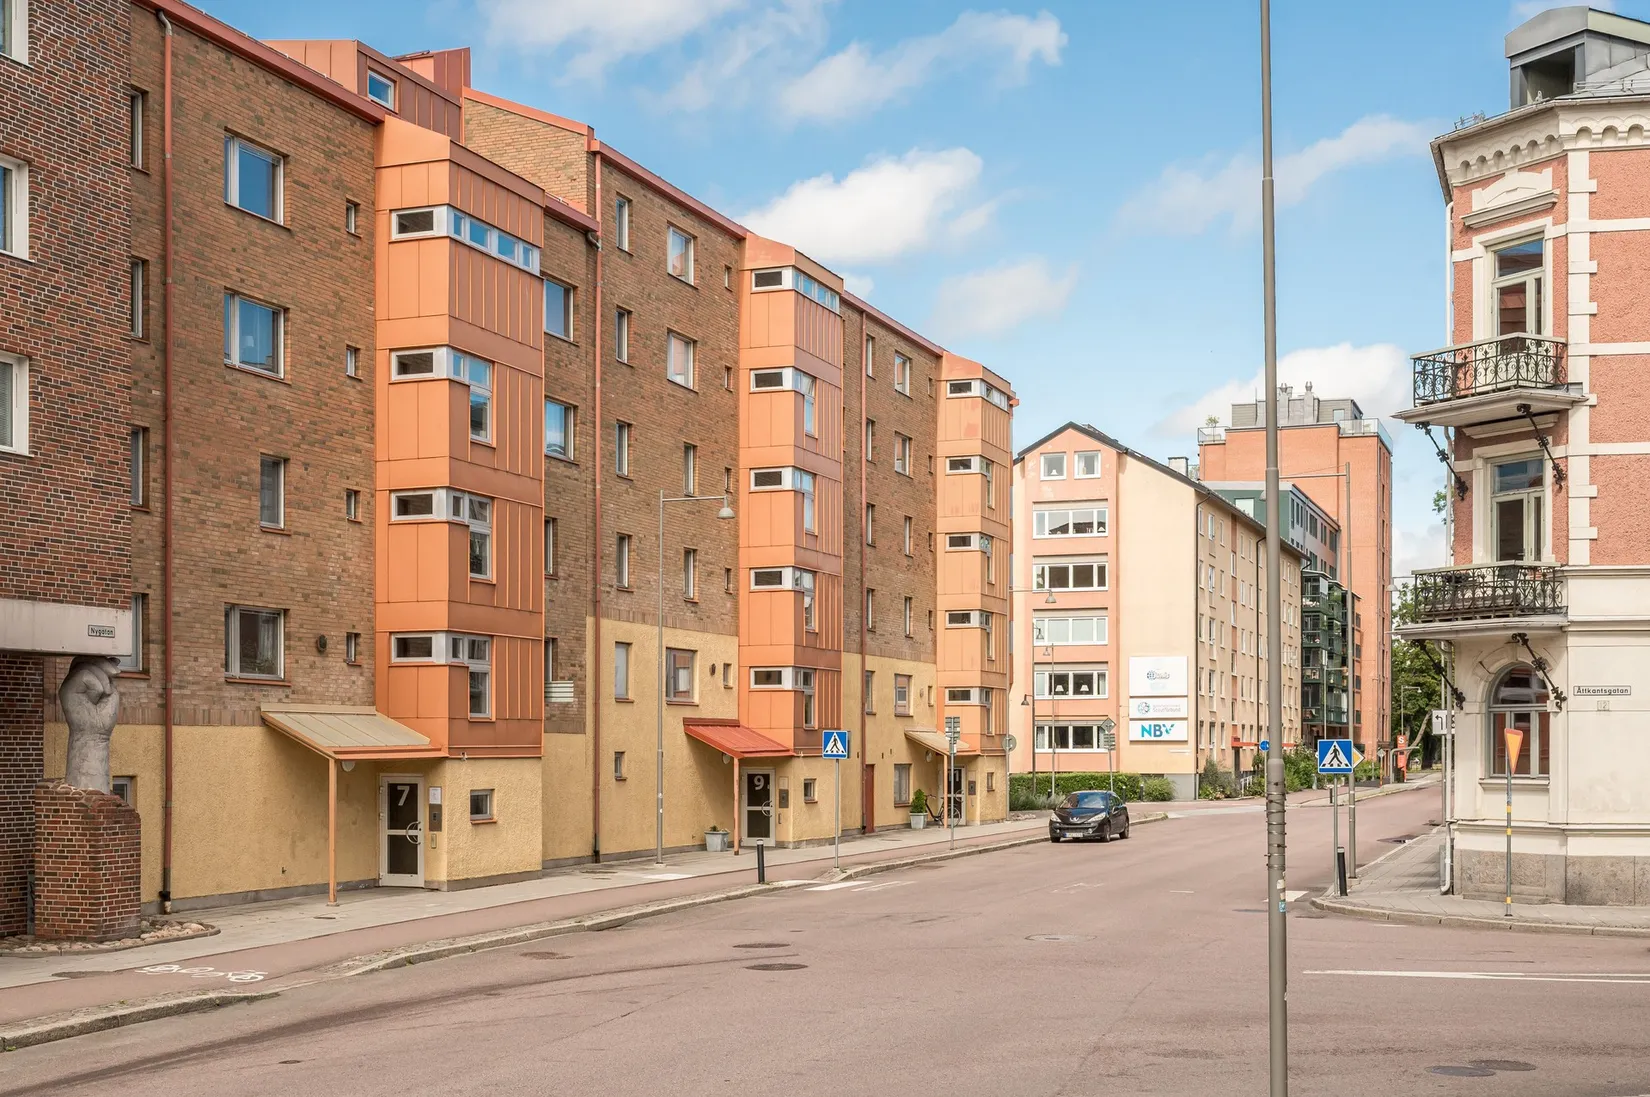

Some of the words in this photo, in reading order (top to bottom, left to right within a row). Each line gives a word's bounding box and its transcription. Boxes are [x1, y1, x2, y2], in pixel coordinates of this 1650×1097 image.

[1577, 686, 1629, 695] Åttkantsgatan
[1141, 724, 1175, 738] NBV
[753, 775, 765, 790] 9
[397, 785, 410, 806] 7
